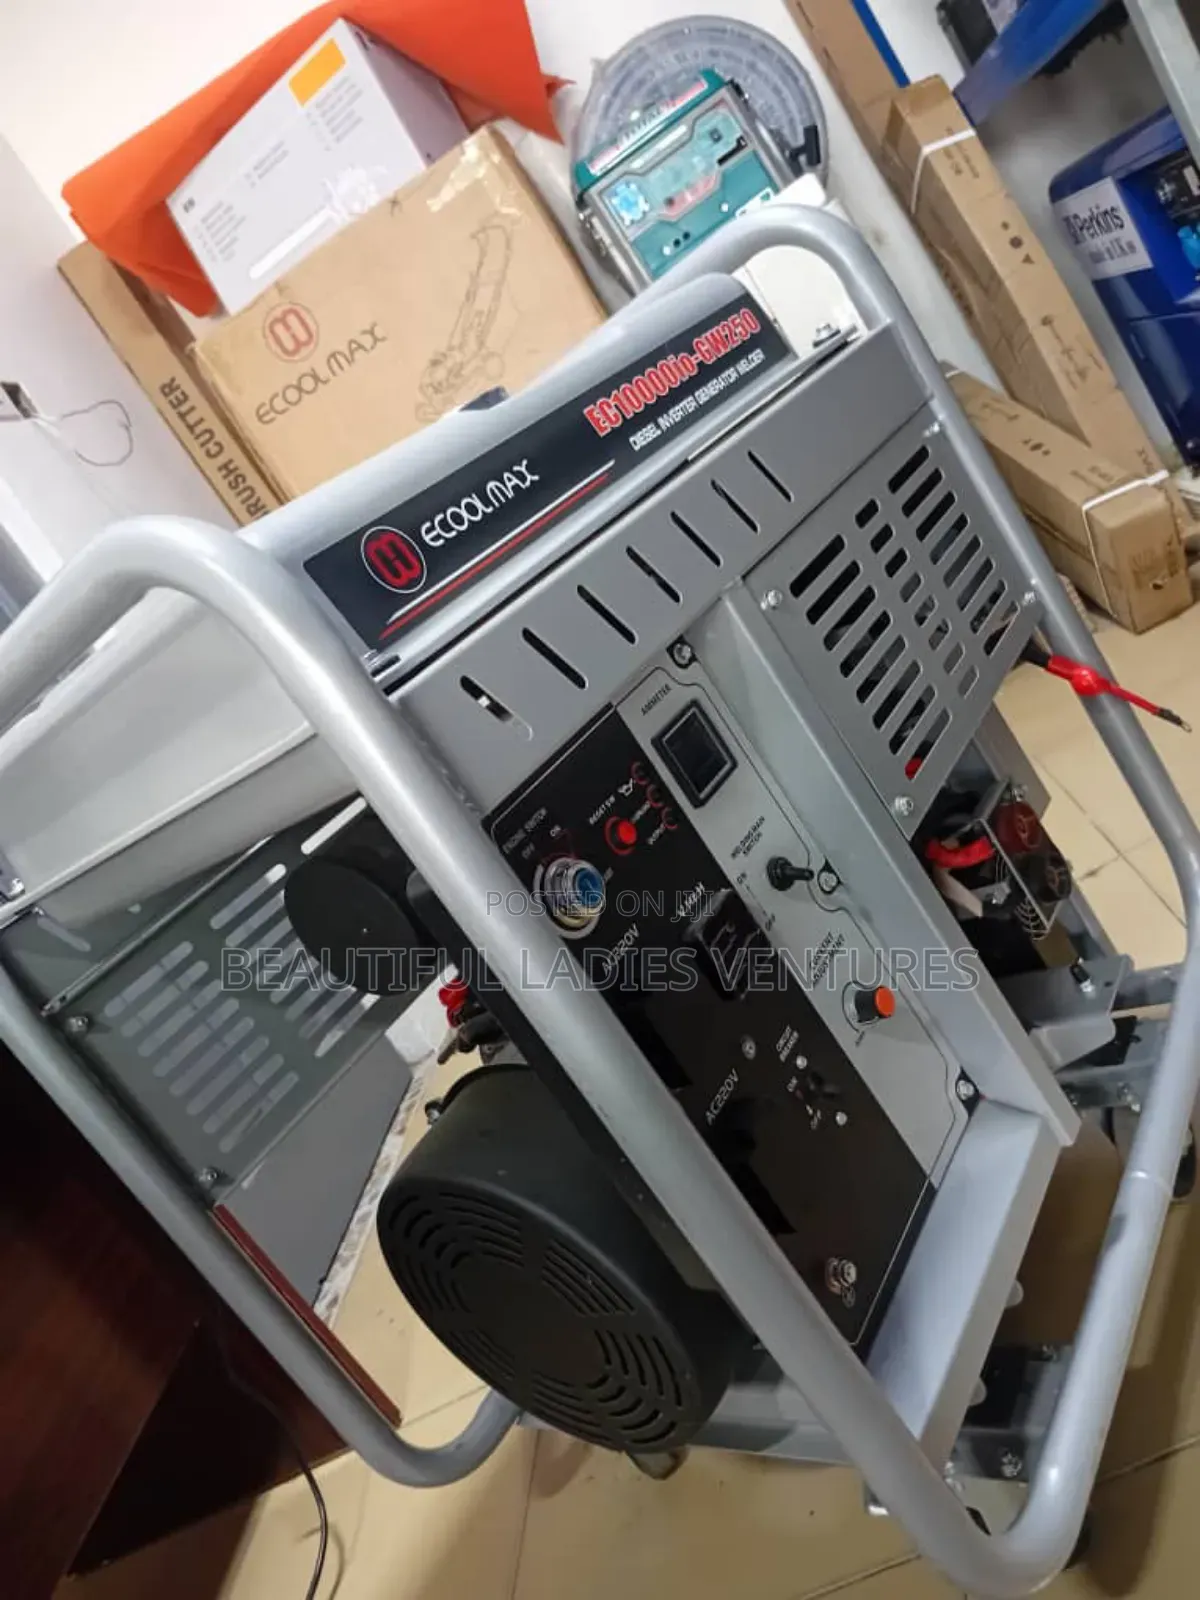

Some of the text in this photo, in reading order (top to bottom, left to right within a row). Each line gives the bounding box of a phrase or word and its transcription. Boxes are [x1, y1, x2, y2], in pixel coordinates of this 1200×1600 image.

[158, 376, 225, 460] CUTTER
[628, 347, 767, 451] DIESEL INVERTER GENERATOR WELDER
[420, 458, 540, 547] ECOOLMAX
[704, 1067, 740, 1126] AC220V
